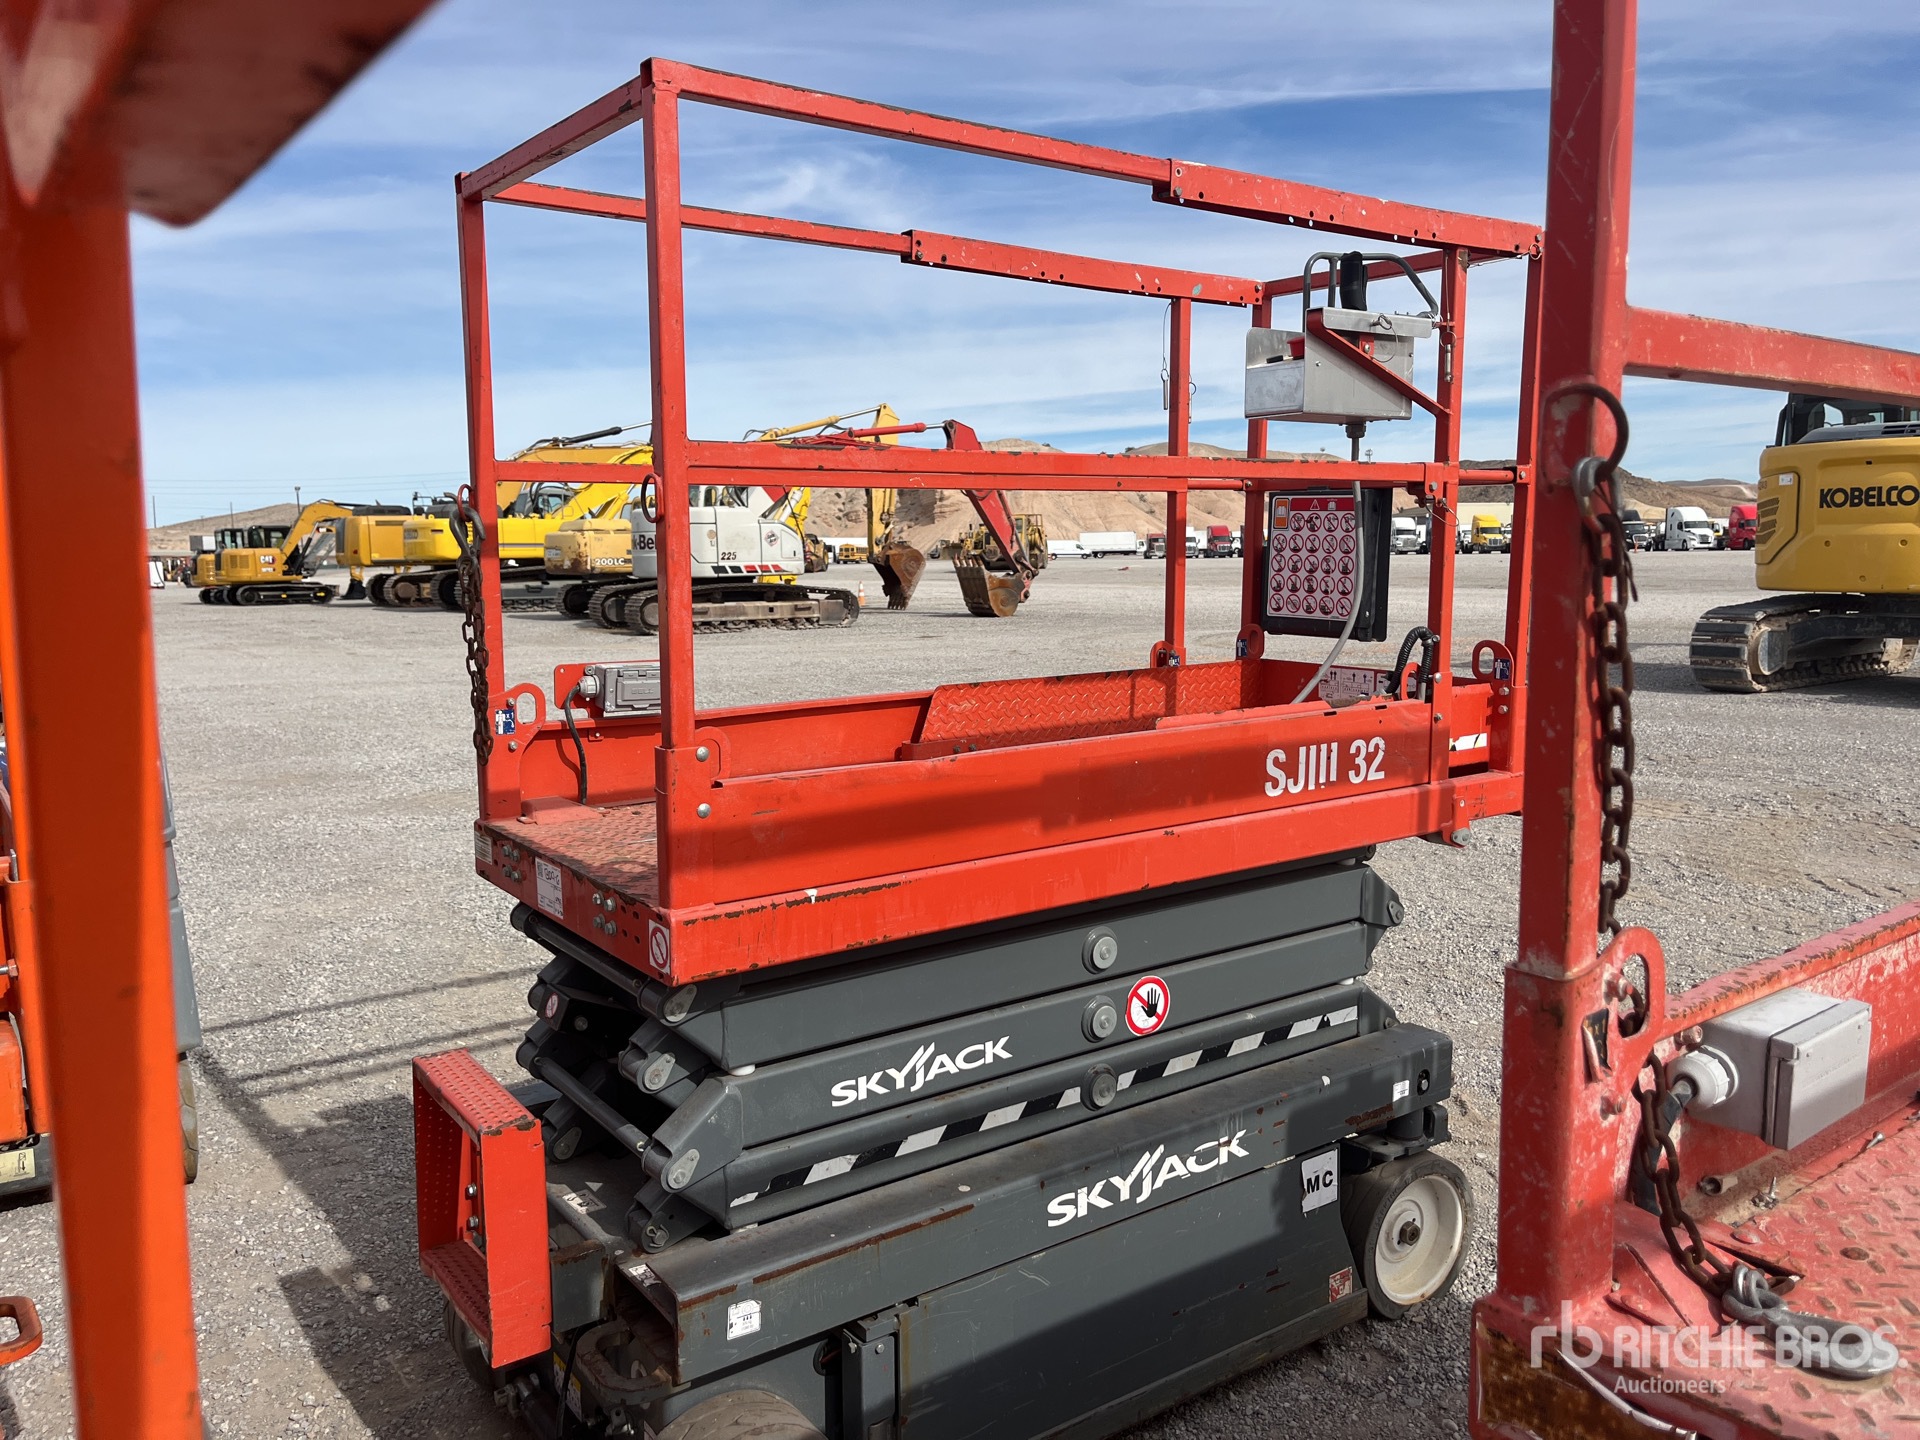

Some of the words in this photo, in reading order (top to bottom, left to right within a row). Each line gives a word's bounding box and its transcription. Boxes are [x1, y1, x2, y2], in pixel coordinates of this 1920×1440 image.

[1819, 485, 1920, 508] KOBELCO
[721, 552, 737, 560] 225
[1348, 736, 1385, 784] 32
[830, 1035, 1013, 1107] SKYJACK
[1046, 1129, 1250, 1227] SKYJACK
